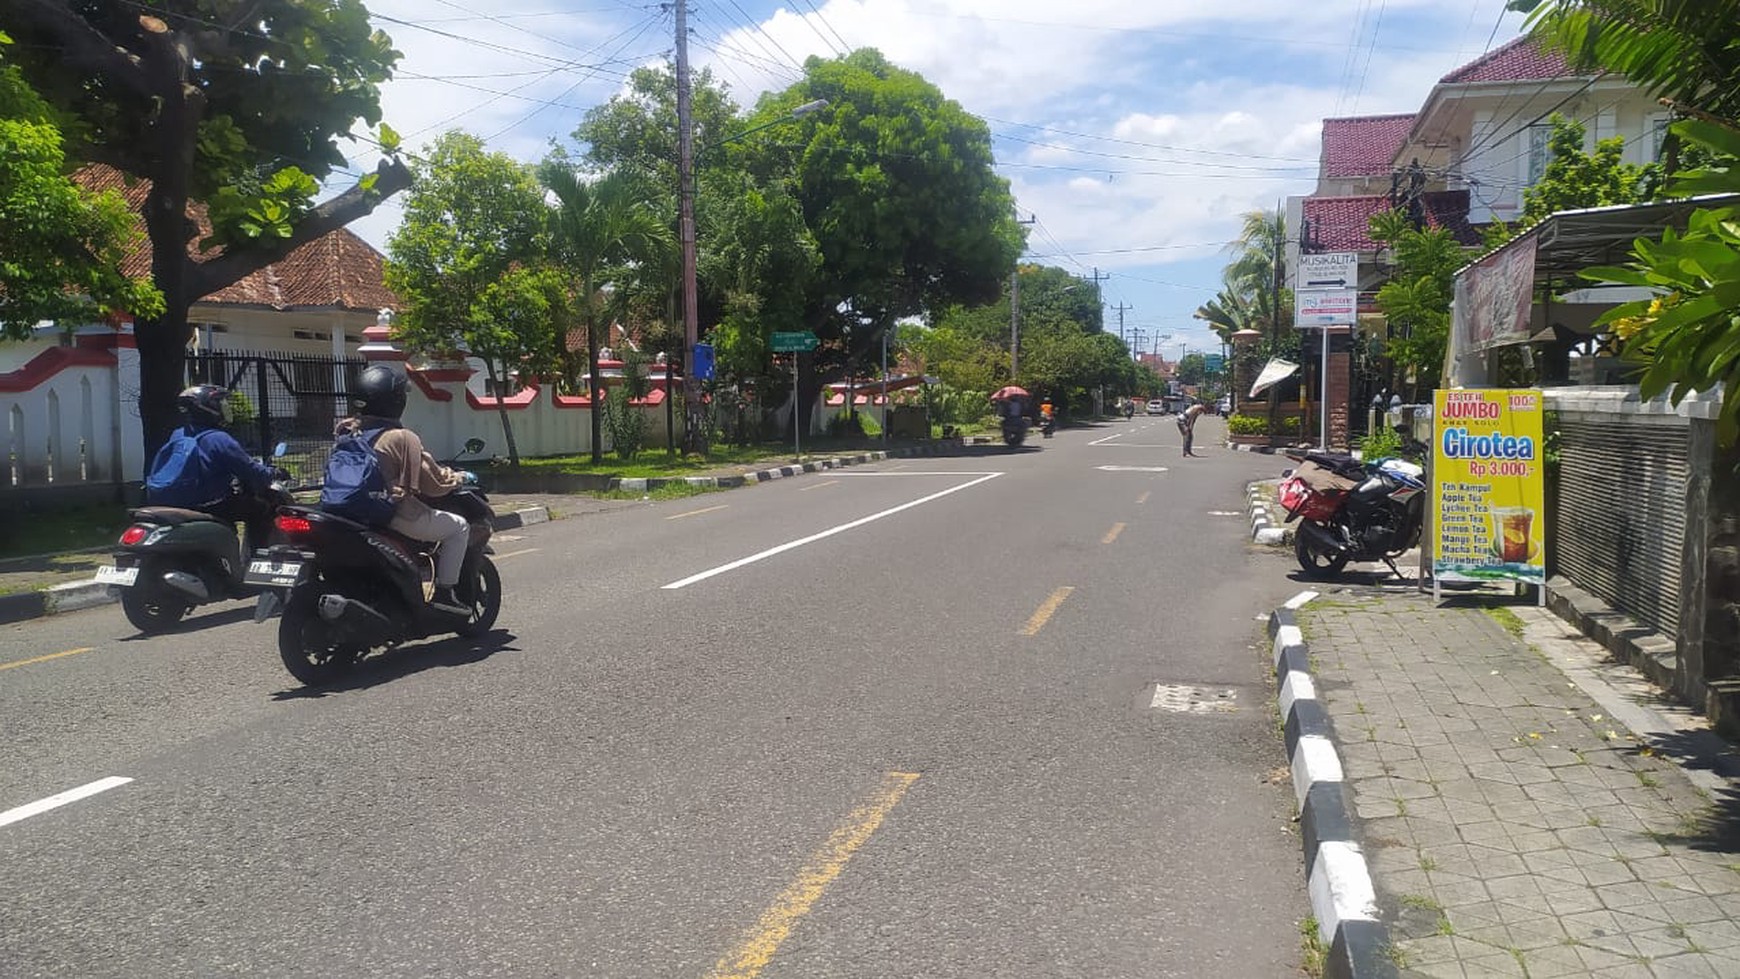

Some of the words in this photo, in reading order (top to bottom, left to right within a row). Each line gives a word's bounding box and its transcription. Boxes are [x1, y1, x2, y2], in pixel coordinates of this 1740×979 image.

[1300, 254, 1356, 266] MUSIKALITA
[1448, 393, 1459, 401] ES
[1462, 393, 1482, 401] TEH
[1442, 402, 1499, 418] JUMBO
[1443, 428, 1533, 458] Cirotea
[1470, 461, 1486, 477] Rp
[1490, 461, 1534, 476] 3.000,-
[1442, 494, 1465, 502] Apple
[1469, 494, 1482, 502] Tea
[1442, 504, 1470, 512] Lychee
[1474, 504, 1488, 512] Tea
[1442, 514, 1466, 522] Green
[1472, 525, 1486, 533] Tea
[1442, 535, 1469, 544] Mango
[1474, 535, 1487, 543] Tea
[1474, 545, 1488, 553] Tea
[1487, 556, 1503, 565] Tea
